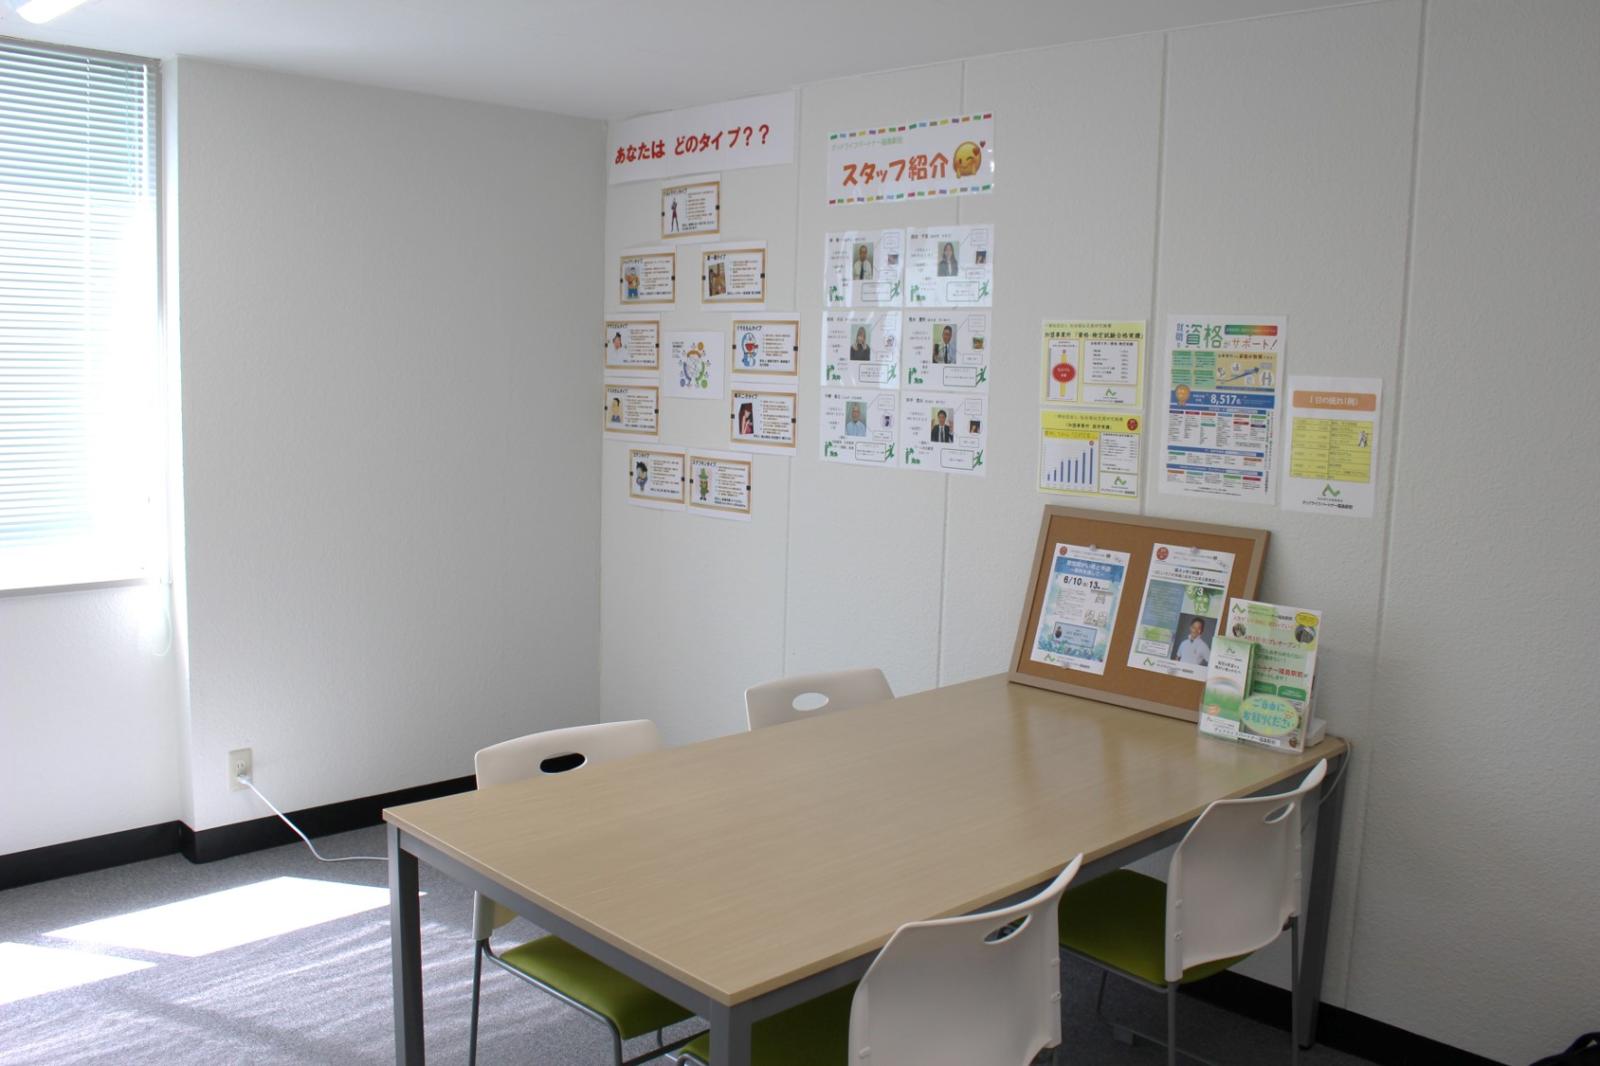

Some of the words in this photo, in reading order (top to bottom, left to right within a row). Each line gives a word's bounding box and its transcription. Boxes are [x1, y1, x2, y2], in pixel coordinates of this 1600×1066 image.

[614, 139, 666, 165] あなたは
[674, 124, 770, 156] どのタイプ？？
[842, 151, 949, 187] スタッフ紹介
